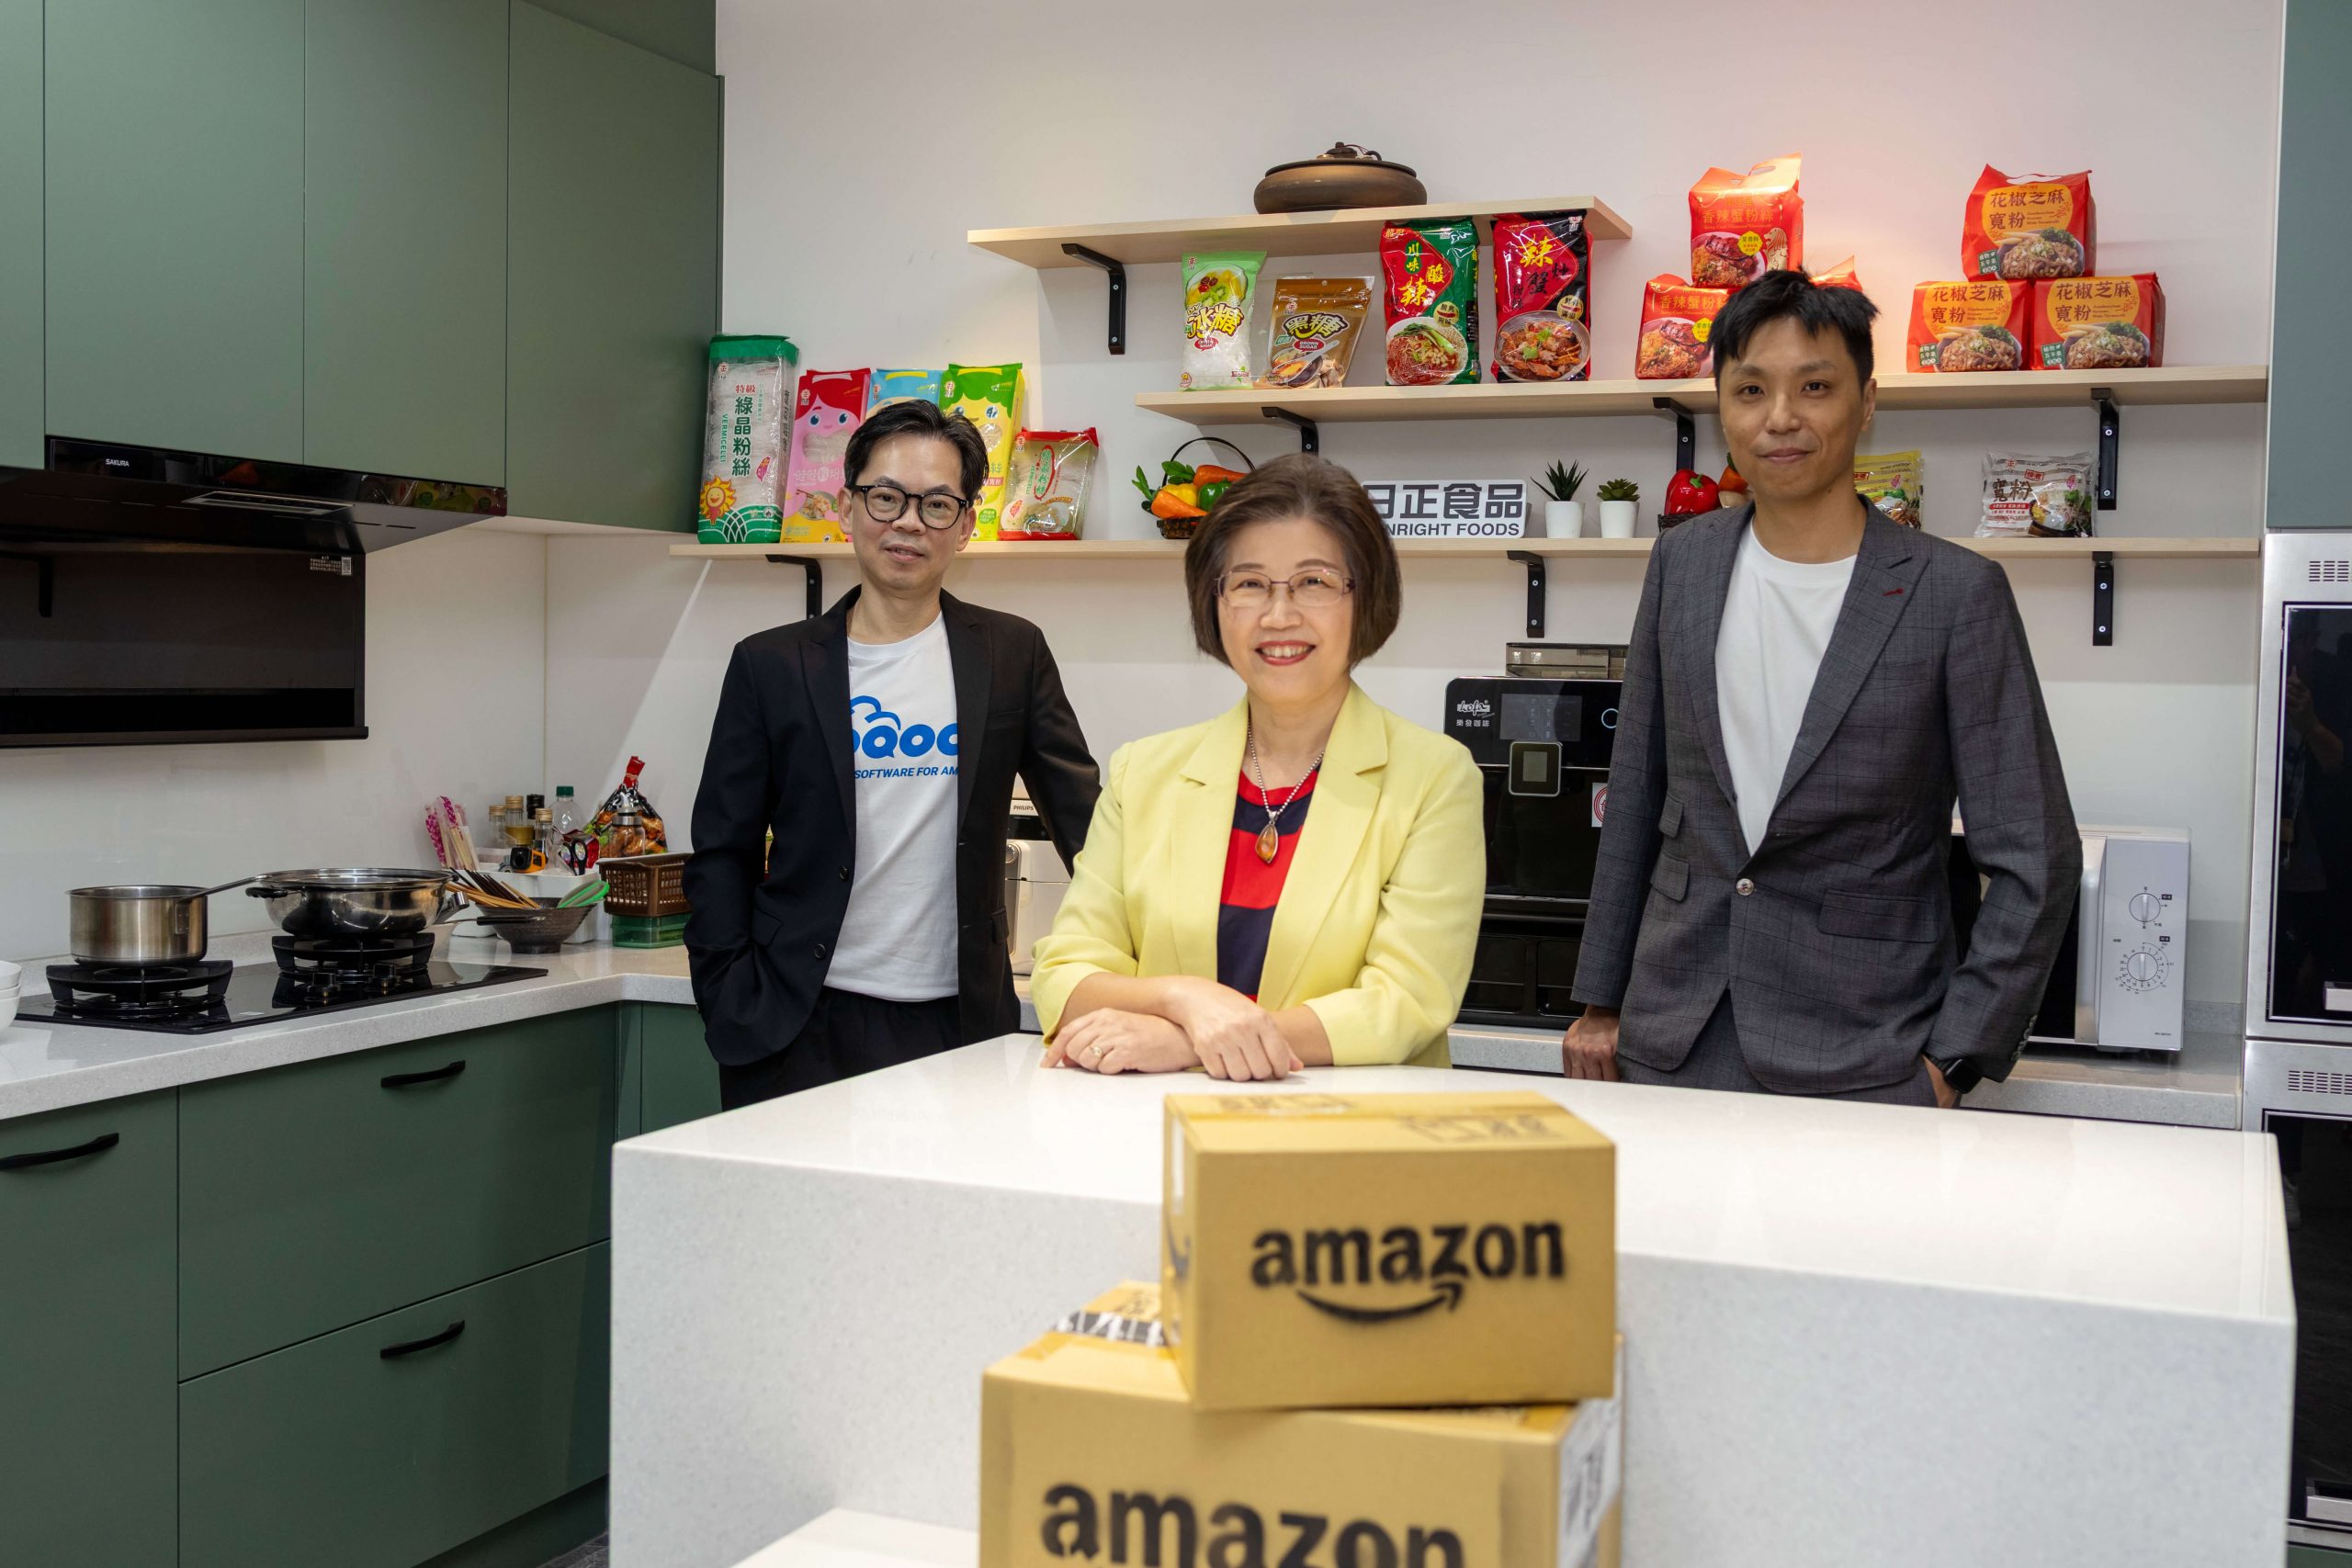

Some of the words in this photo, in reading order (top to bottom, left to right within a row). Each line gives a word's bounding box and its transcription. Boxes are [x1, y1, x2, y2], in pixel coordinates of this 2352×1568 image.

[1990, 188, 2065, 209] 花椒芝麻
[1989, 212, 2026, 230] 寬粉
[1406, 243, 1419, 272] 川味
[1932, 284, 2005, 302] 花椒芝麻
[2056, 280, 2132, 300] 花椒芝麻
[1187, 303, 1244, 339] 冰糖
[1931, 307, 1966, 323] 寬粉
[2055, 305, 2092, 322] 寬粉
[1283, 313, 1347, 339] 黑糖
[736, 384, 756, 394] 特級
[719, 413, 729, 462] VERMICELLI
[731, 396, 753, 477] 綠晶粉絲
[106, 458, 130, 467] SAKURA
[1992, 479, 2033, 502] 寬粉
[1363, 483, 1523, 520] 日正食品
[1456, 523, 1520, 536] FOODS
[854, 768, 914, 779] SOFTWARE
[916, 766, 938, 776] FOR
[1250, 1221, 1564, 1289] amazon
